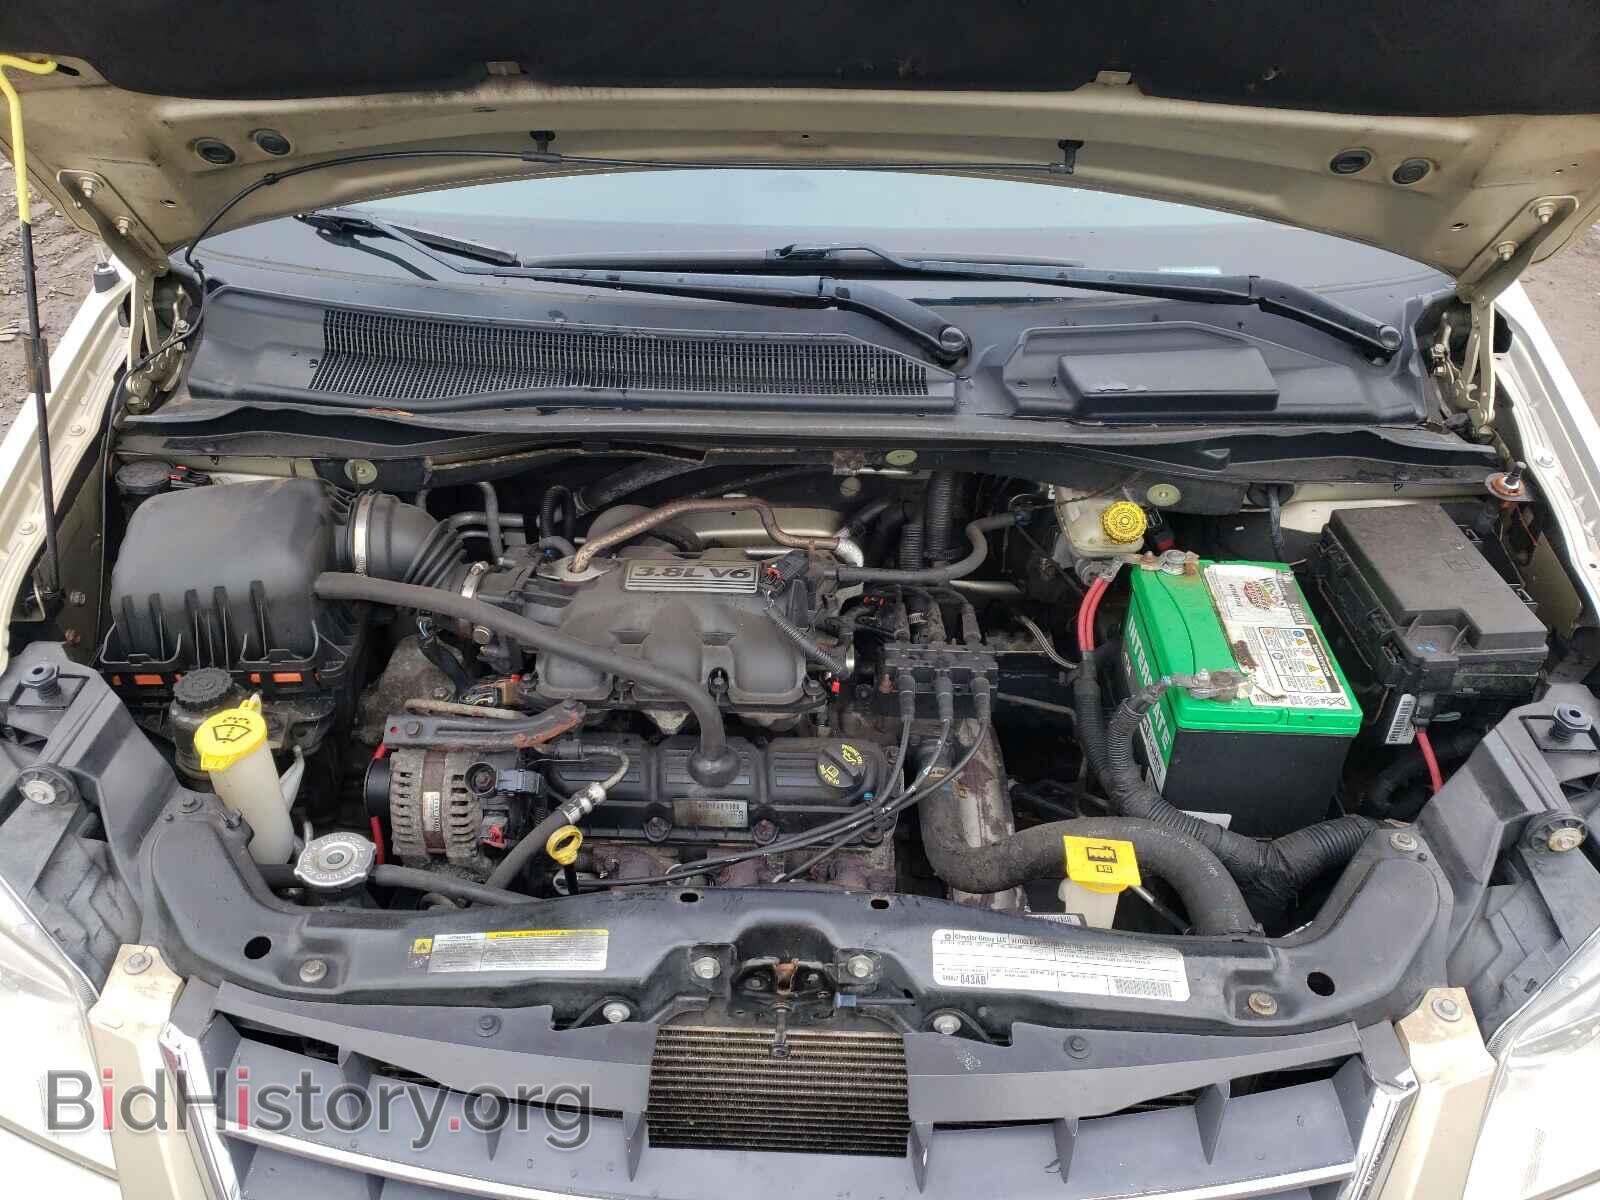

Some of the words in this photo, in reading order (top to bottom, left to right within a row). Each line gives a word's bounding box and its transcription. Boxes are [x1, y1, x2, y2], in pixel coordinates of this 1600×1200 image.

[634, 566, 705, 578] 3.8L
[708, 567, 752, 579] V6
[1129, 615, 1172, 750] INTERSATE
